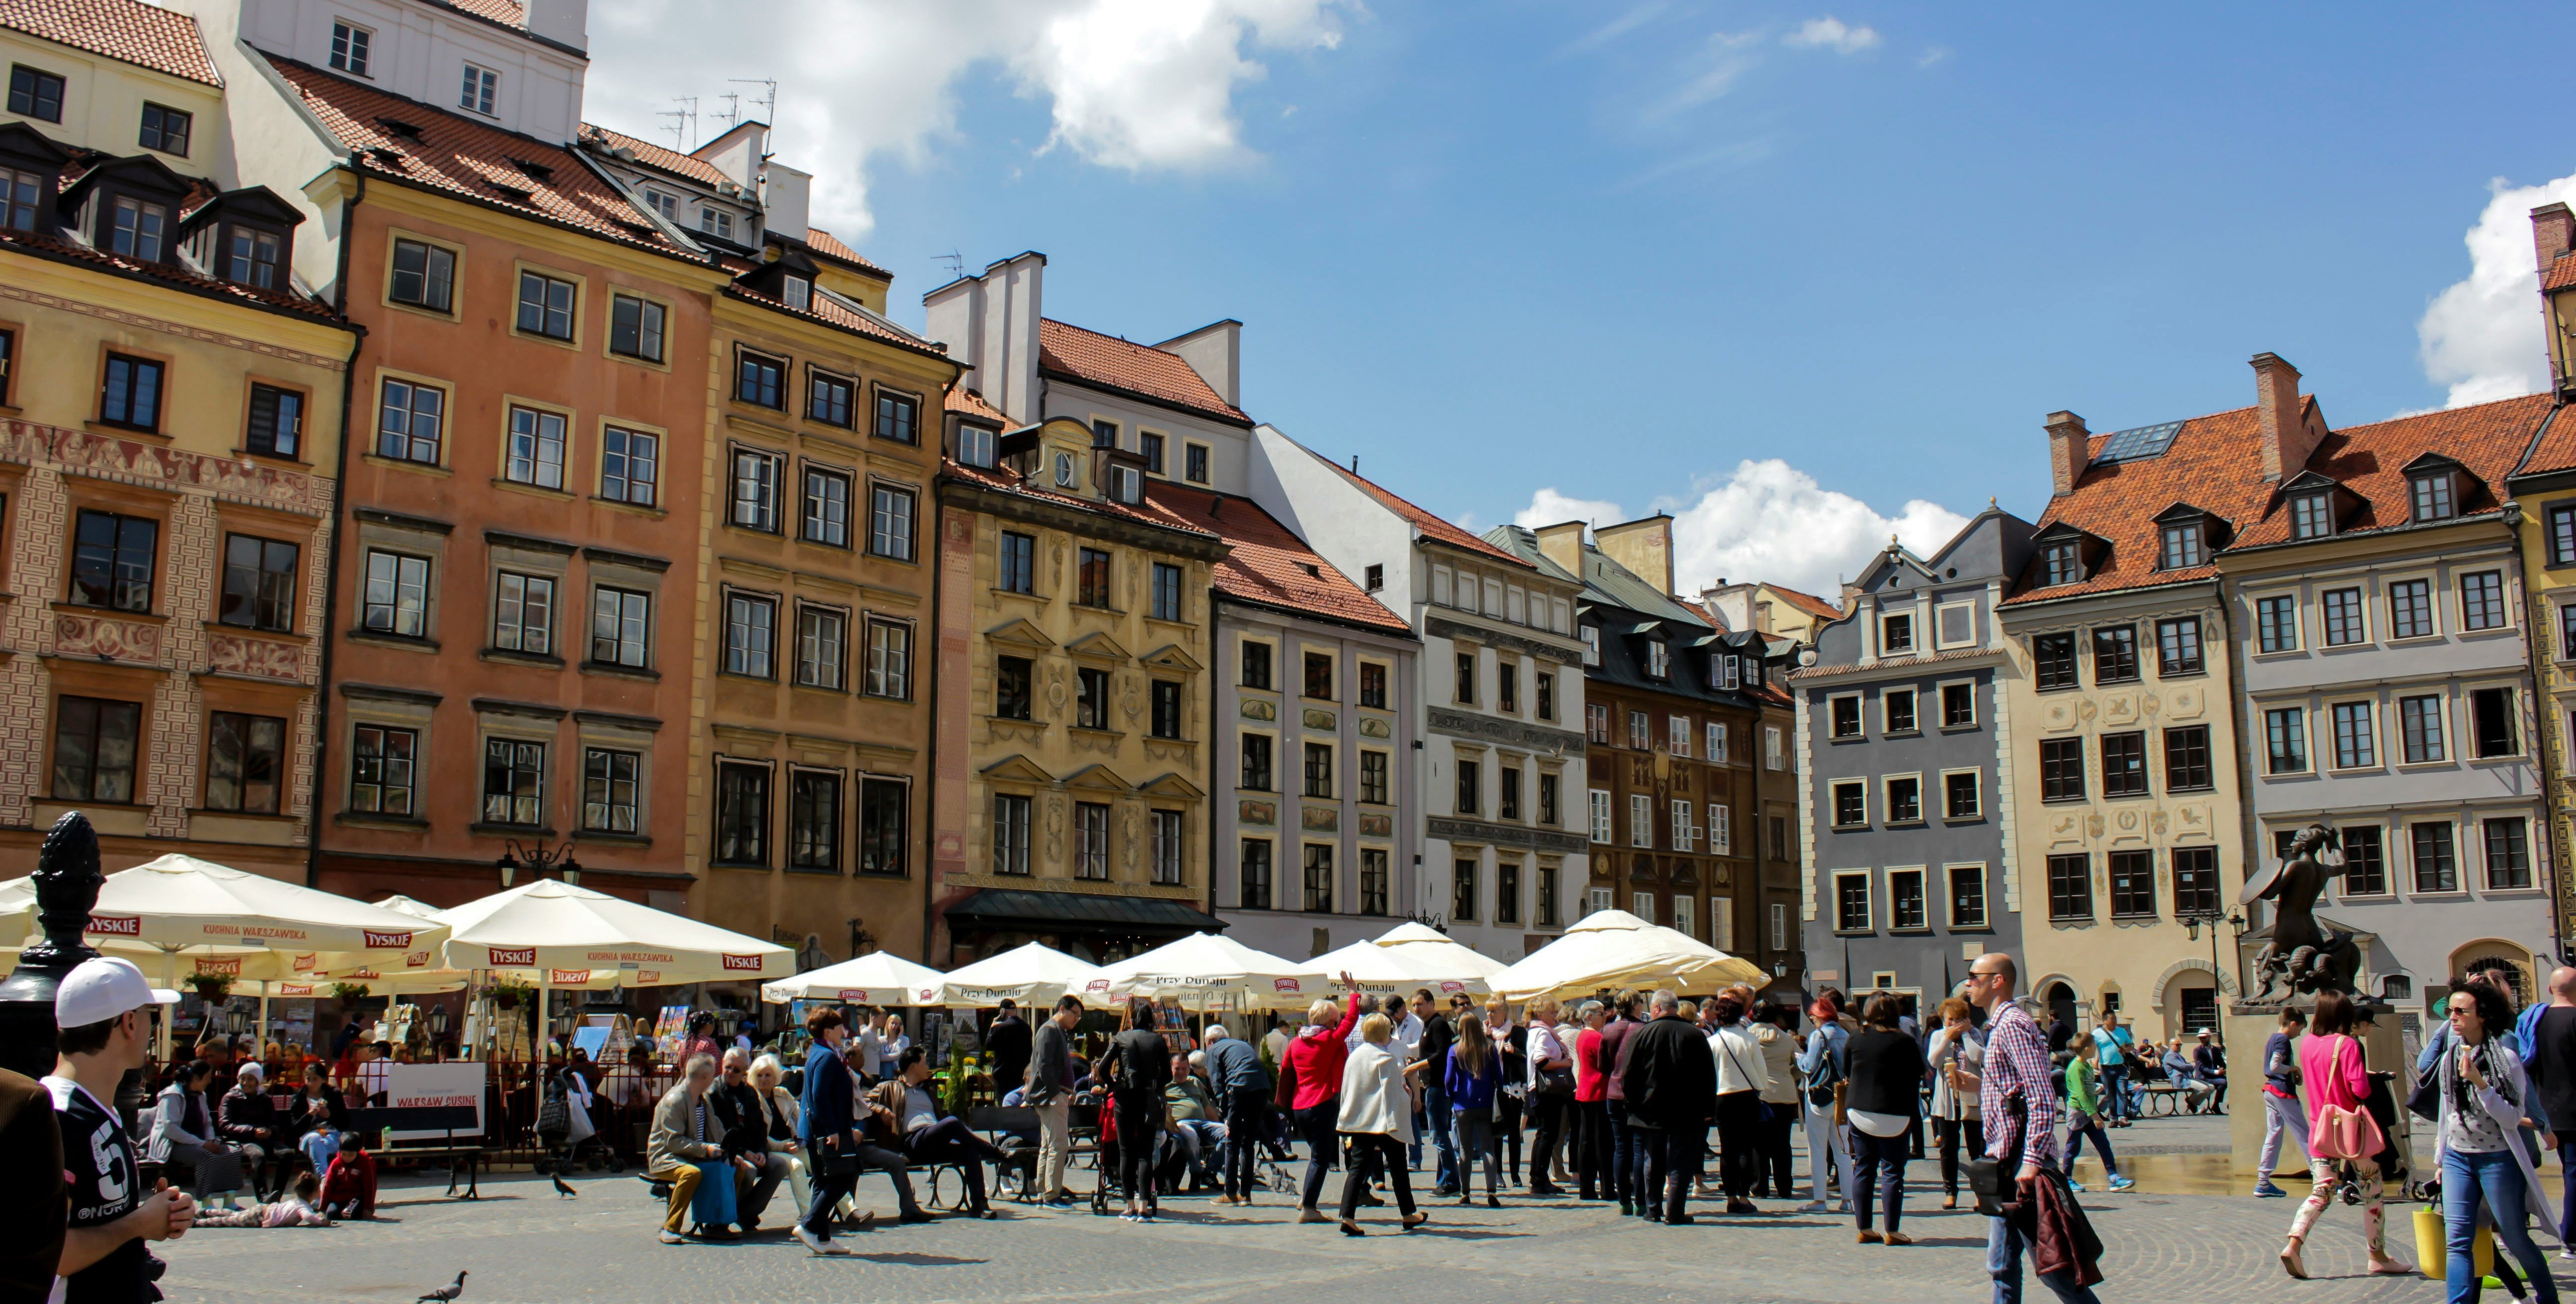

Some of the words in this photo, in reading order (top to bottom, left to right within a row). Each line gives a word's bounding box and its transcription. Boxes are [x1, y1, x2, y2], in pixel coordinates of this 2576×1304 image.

[203, 924, 240, 935] KUCHNIA
[243, 926, 306, 939] WARSZAWSKA
[367, 933, 410, 945] TYSKIE
[491, 950, 533, 963] TYSKIE
[588, 952, 619, 961] KUCHNIA
[621, 953, 674, 962] WARSZAWSKA
[724, 955, 760, 968] TYSKIE
[1186, 977, 1226, 988] Dunaju
[1357, 983, 1394, 993] Dunaju
[961, 988, 981, 999] Przy
[986, 988, 1020, 998] Dunaju
[398, 1097, 443, 1107] WARSAW
[446, 1095, 477, 1106] CUSINE
